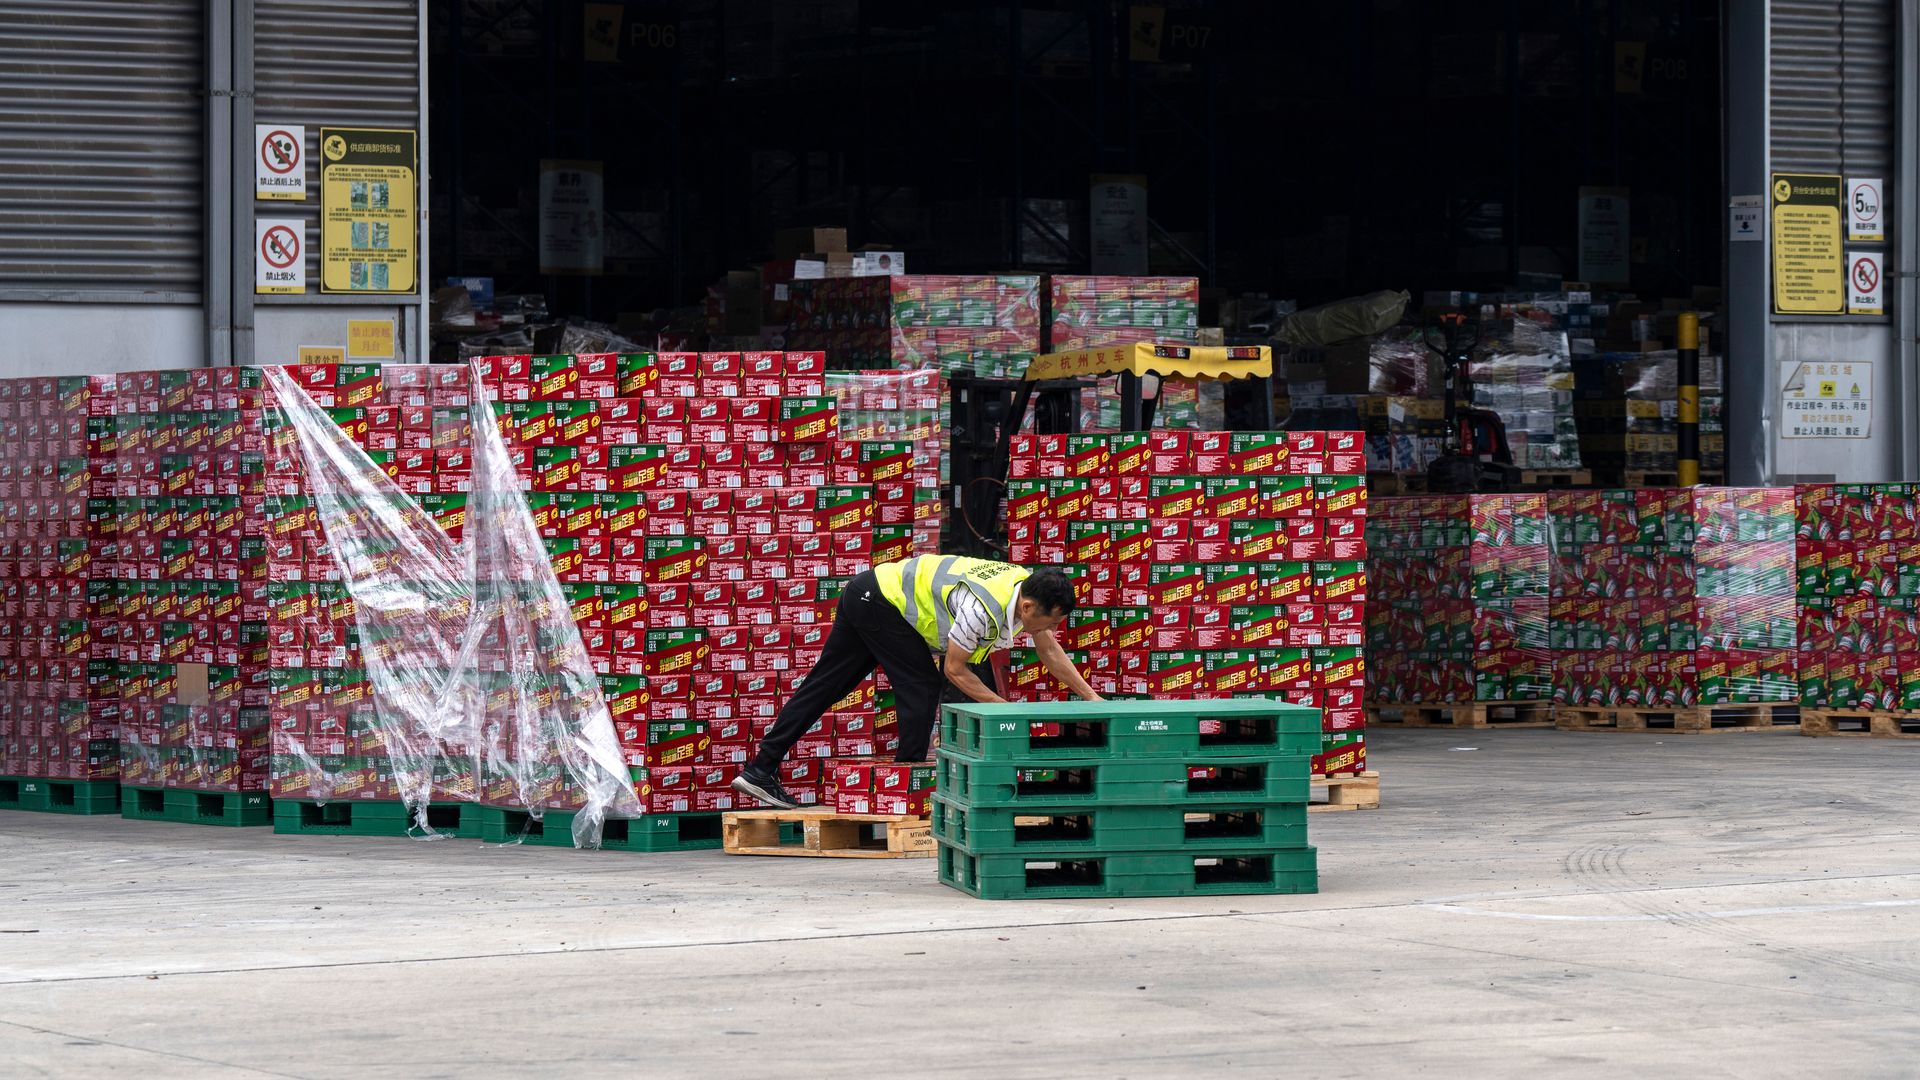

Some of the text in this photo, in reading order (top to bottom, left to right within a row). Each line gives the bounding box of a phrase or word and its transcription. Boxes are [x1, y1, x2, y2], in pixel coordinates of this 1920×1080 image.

[631, 23, 676, 48] P06
[1170, 24, 1212, 49] P07
[1650, 57, 1688, 80] P08
[350, 143, 401, 154] 供应商卸货标准
[260, 177, 302, 187] 禁止酒后上岗
[266, 271, 296, 281] 禁止烟火
[1855, 296, 1876, 304] 禁止烟火
[1060, 354, 1125, 371] 杭州叉车
[1802, 364, 1852, 375] 危险区域
[1000, 723, 1016, 732] PW
[657, 819, 669, 827] PW
